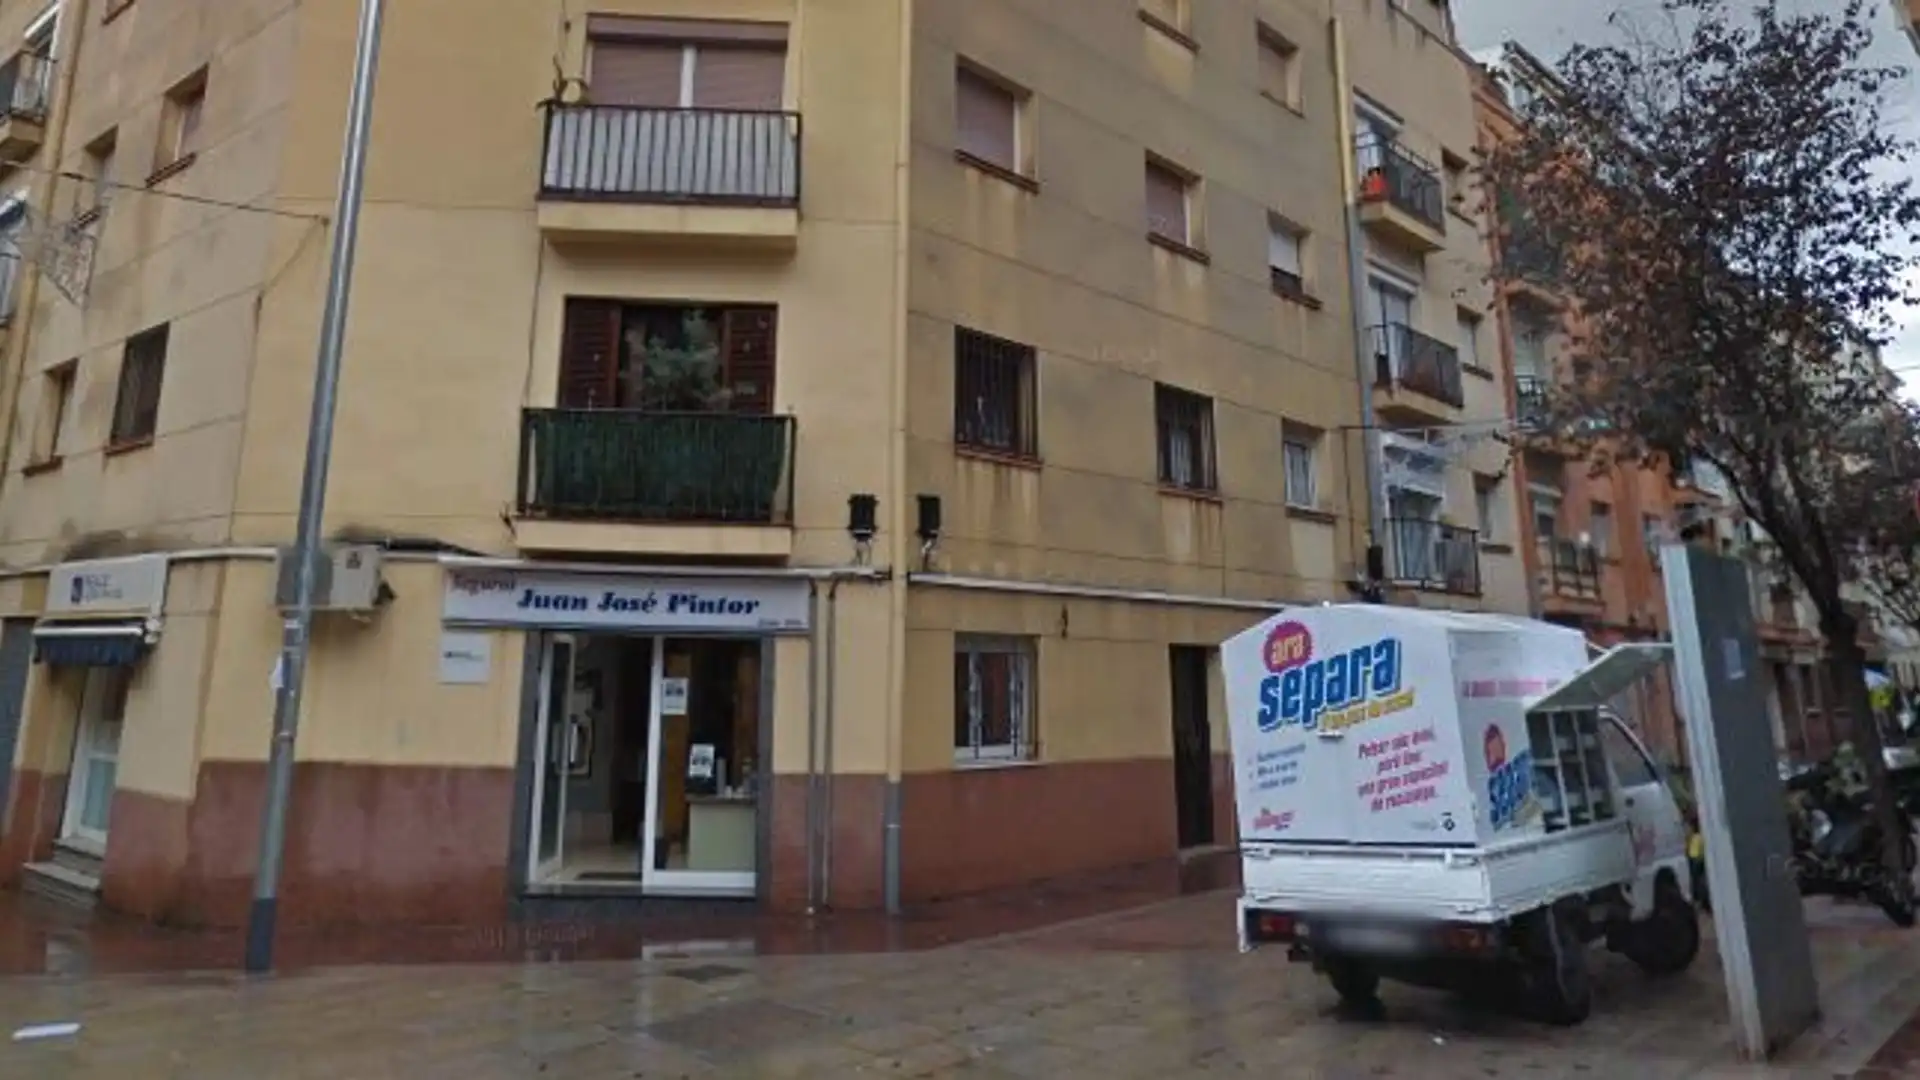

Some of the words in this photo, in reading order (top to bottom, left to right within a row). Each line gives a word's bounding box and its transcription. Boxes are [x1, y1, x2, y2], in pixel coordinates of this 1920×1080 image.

[517, 588, 588, 611] Juan
[597, 591, 658, 614] José
[667, 592, 760, 615] Pintor
[1270, 634, 1305, 664] ara
[1258, 638, 1402, 732] separa
